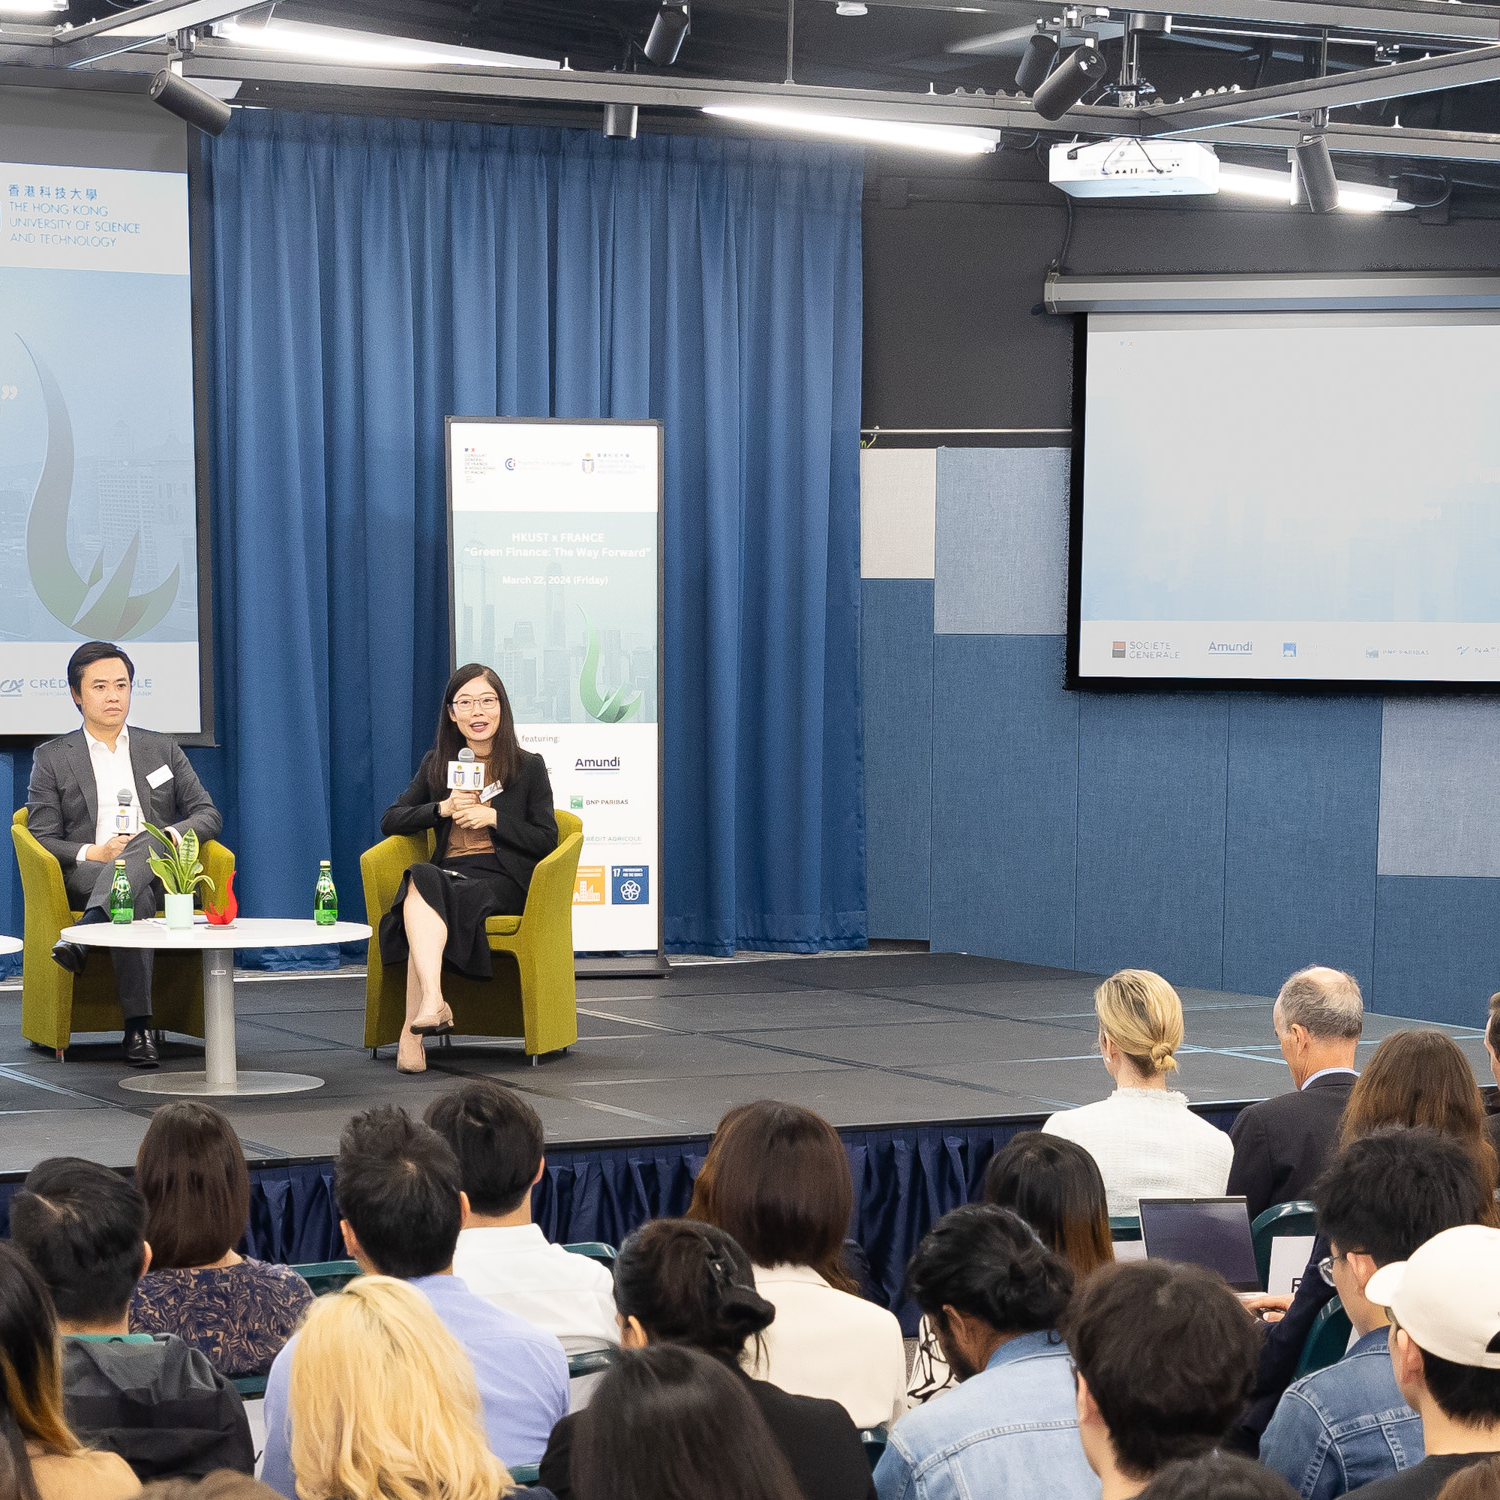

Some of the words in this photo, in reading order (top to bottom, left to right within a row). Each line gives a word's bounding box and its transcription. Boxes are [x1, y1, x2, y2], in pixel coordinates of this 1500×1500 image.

[8, 184, 98, 201] 香港科技大學
[9, 201, 28, 212] THE
[33, 203, 70, 215] HONG
[73, 205, 109, 217] KONG
[10, 218, 71, 230] UNIVERSITY
[76, 220, 90, 231] OF
[95, 222, 140, 234] SCIENCE
[10, 233, 35, 244] AND
[40, 234, 117, 248] TECHNOLOGY
[511, 533, 549, 543] HKUST
[560, 533, 605, 543] FRANCE
[554, 547, 574, 557] The
[576, 548, 600, 559] Way
[502, 576, 532, 585] March
[573, 576, 609, 586] (Friday)
[1129, 641, 1172, 650] SOCIETE
[1207, 641, 1253, 652] Amundi
[1129, 650, 1181, 659] GENERALE
[30, 677, 68, 689] CRÉD
[575, 756, 620, 767] Amundi
[613, 868, 621, 878] 17
